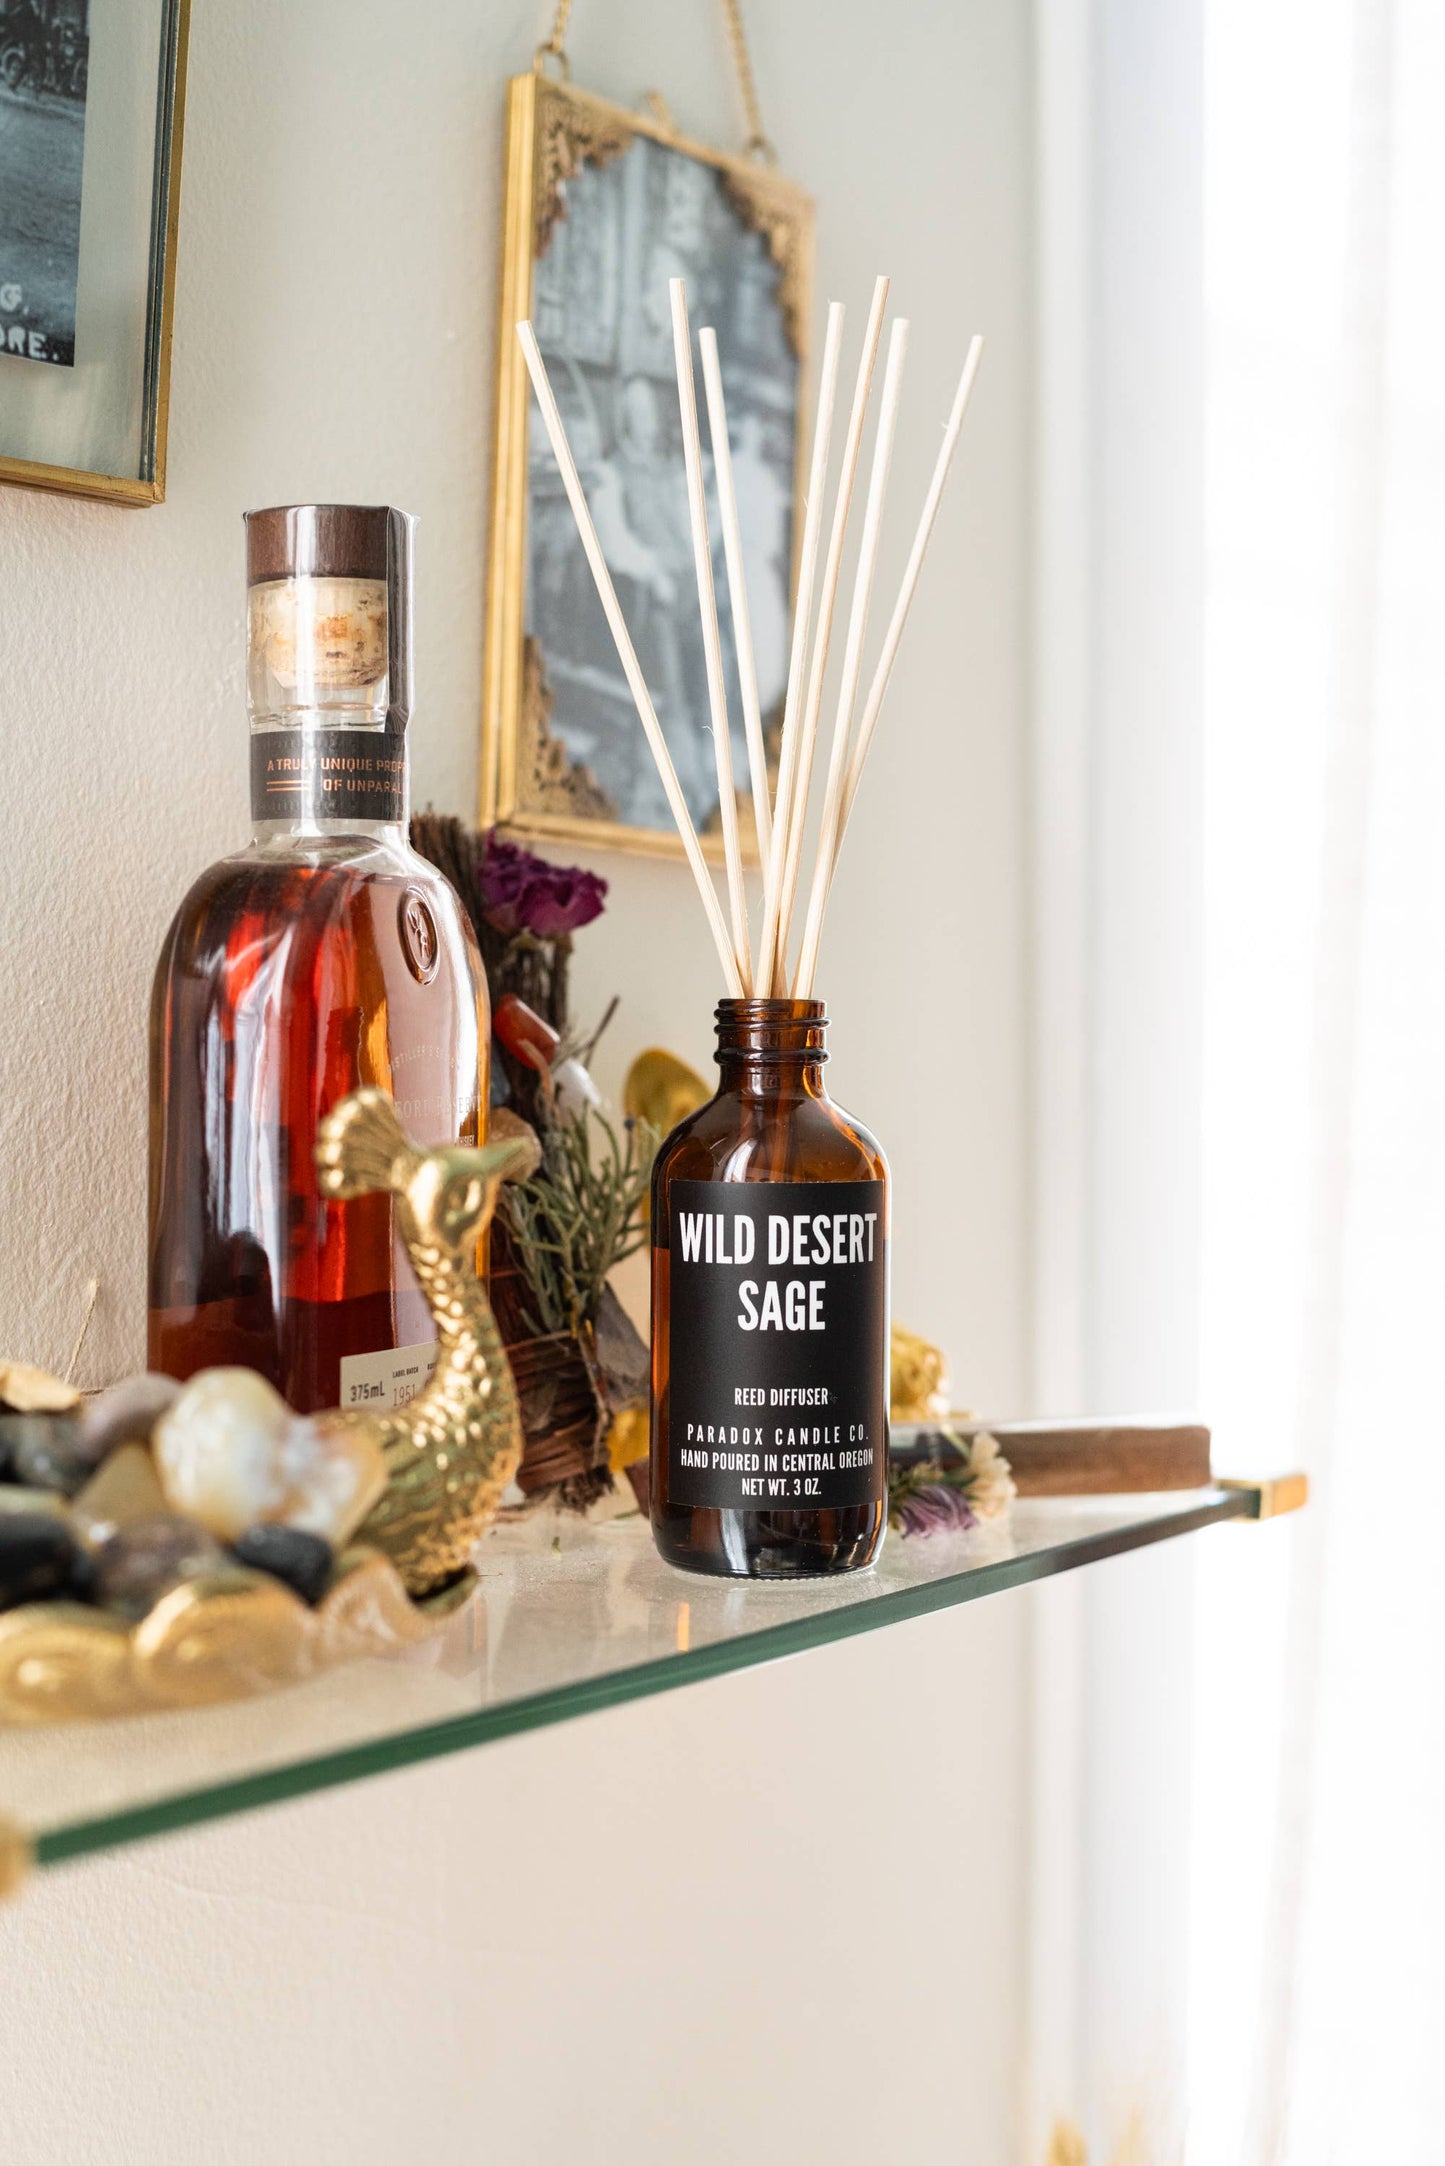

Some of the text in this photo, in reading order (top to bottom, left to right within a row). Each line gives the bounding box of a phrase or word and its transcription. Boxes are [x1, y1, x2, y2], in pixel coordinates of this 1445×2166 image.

[267, 759, 274, 772] A
[276, 758, 316, 770] TRULY
[320, 757, 373, 773] UNIQUE
[323, 778, 343, 791] OF
[679, 1212, 878, 1266] WILD DESERT
[737, 1280, 826, 1332] SAGE
[350, 1380, 416, 1407] 375mL 1951
[734, 1387, 829, 1406] REED DIFFUSER
[687, 1423, 869, 1446] PARADOX CANDLE CO.
[680, 1448, 874, 1472] HAND POURED IN CENTRAL OREGON
[741, 1477, 822, 1496] NET WT. 3 OZ.
